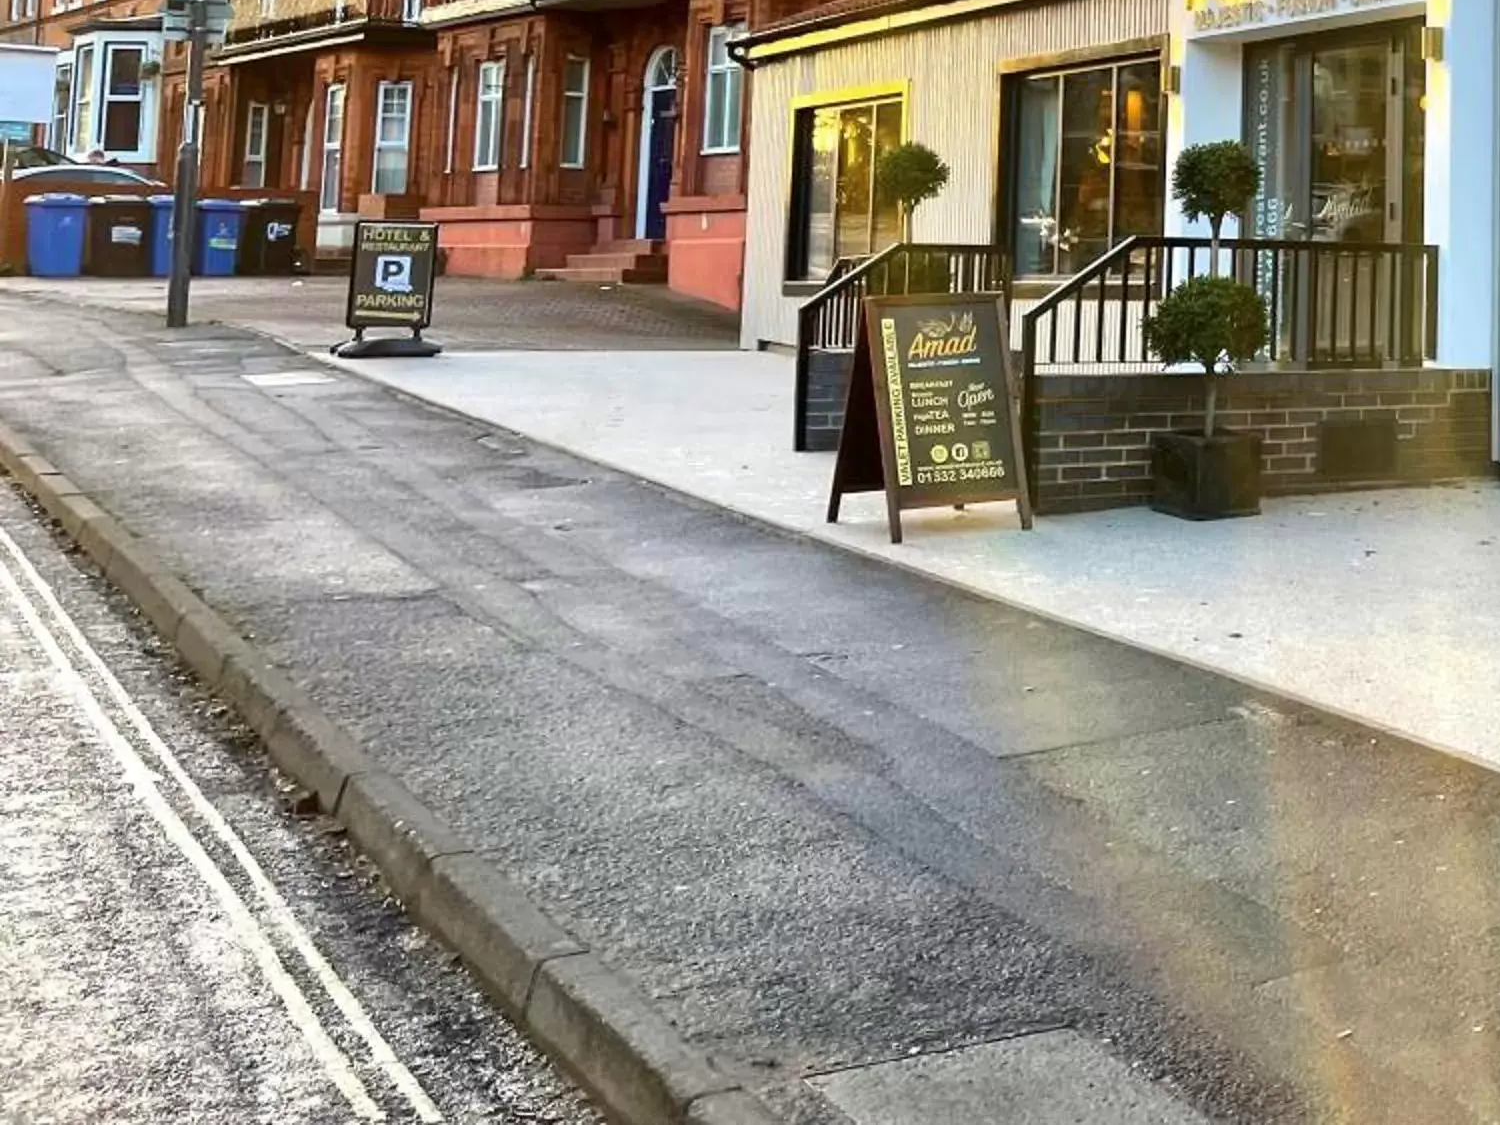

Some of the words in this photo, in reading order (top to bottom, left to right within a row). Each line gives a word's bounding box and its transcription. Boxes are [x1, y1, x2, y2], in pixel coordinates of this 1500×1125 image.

[363, 227, 413, 241] HOTEL
[419, 230, 431, 241] &
[362, 242, 430, 251] RESTAURANT
[382, 260, 404, 282] P
[357, 294, 424, 307] PARKING
[908, 324, 977, 360] Amad
[911, 396, 948, 407] LUNCH
[892, 389, 906, 441] PARKING
[915, 423, 955, 435] DINNER
